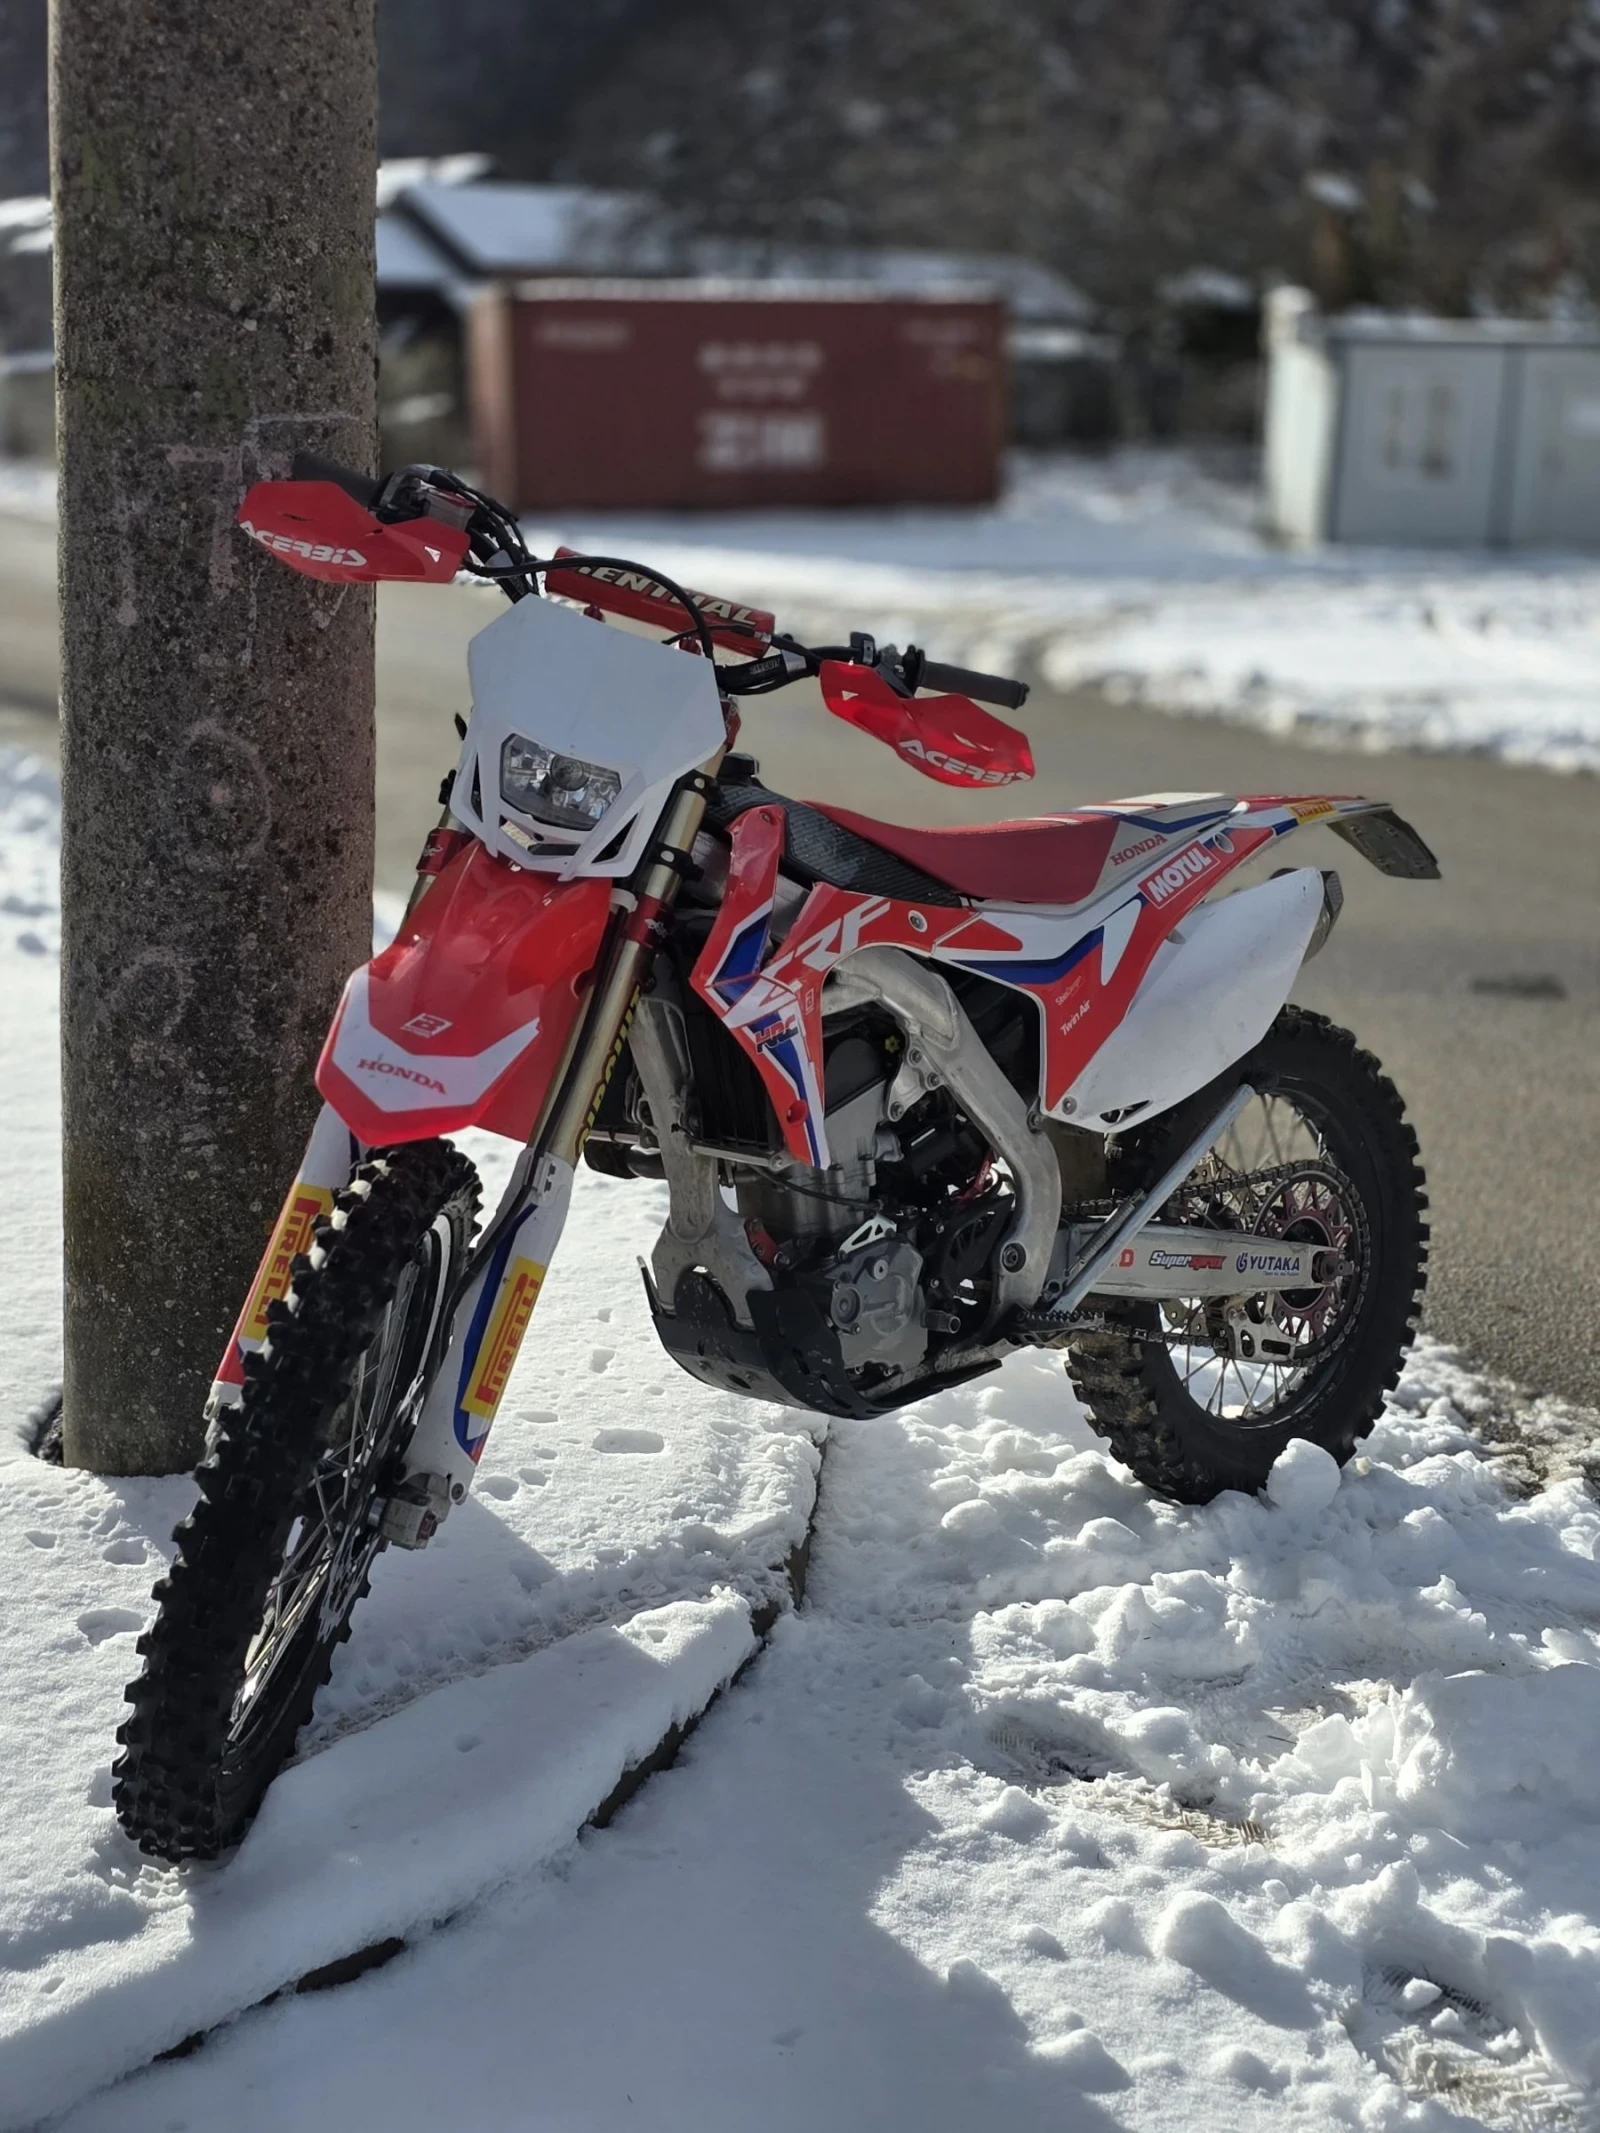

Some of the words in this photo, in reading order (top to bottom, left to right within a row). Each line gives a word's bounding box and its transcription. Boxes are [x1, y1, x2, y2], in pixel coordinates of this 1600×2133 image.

[1108, 834, 1168, 866] HONDA
[1147, 847, 1212, 903] MOTUL
[754, 1013, 800, 1055] HRC
[1060, 1012, 1080, 1036] Twin
[1079, 999, 1090, 1017] Air
[357, 1059, 447, 1095] HONDA
[1250, 1255, 1300, 1271] YUTAKA
[475, 1273, 541, 1406] PIRELLI
